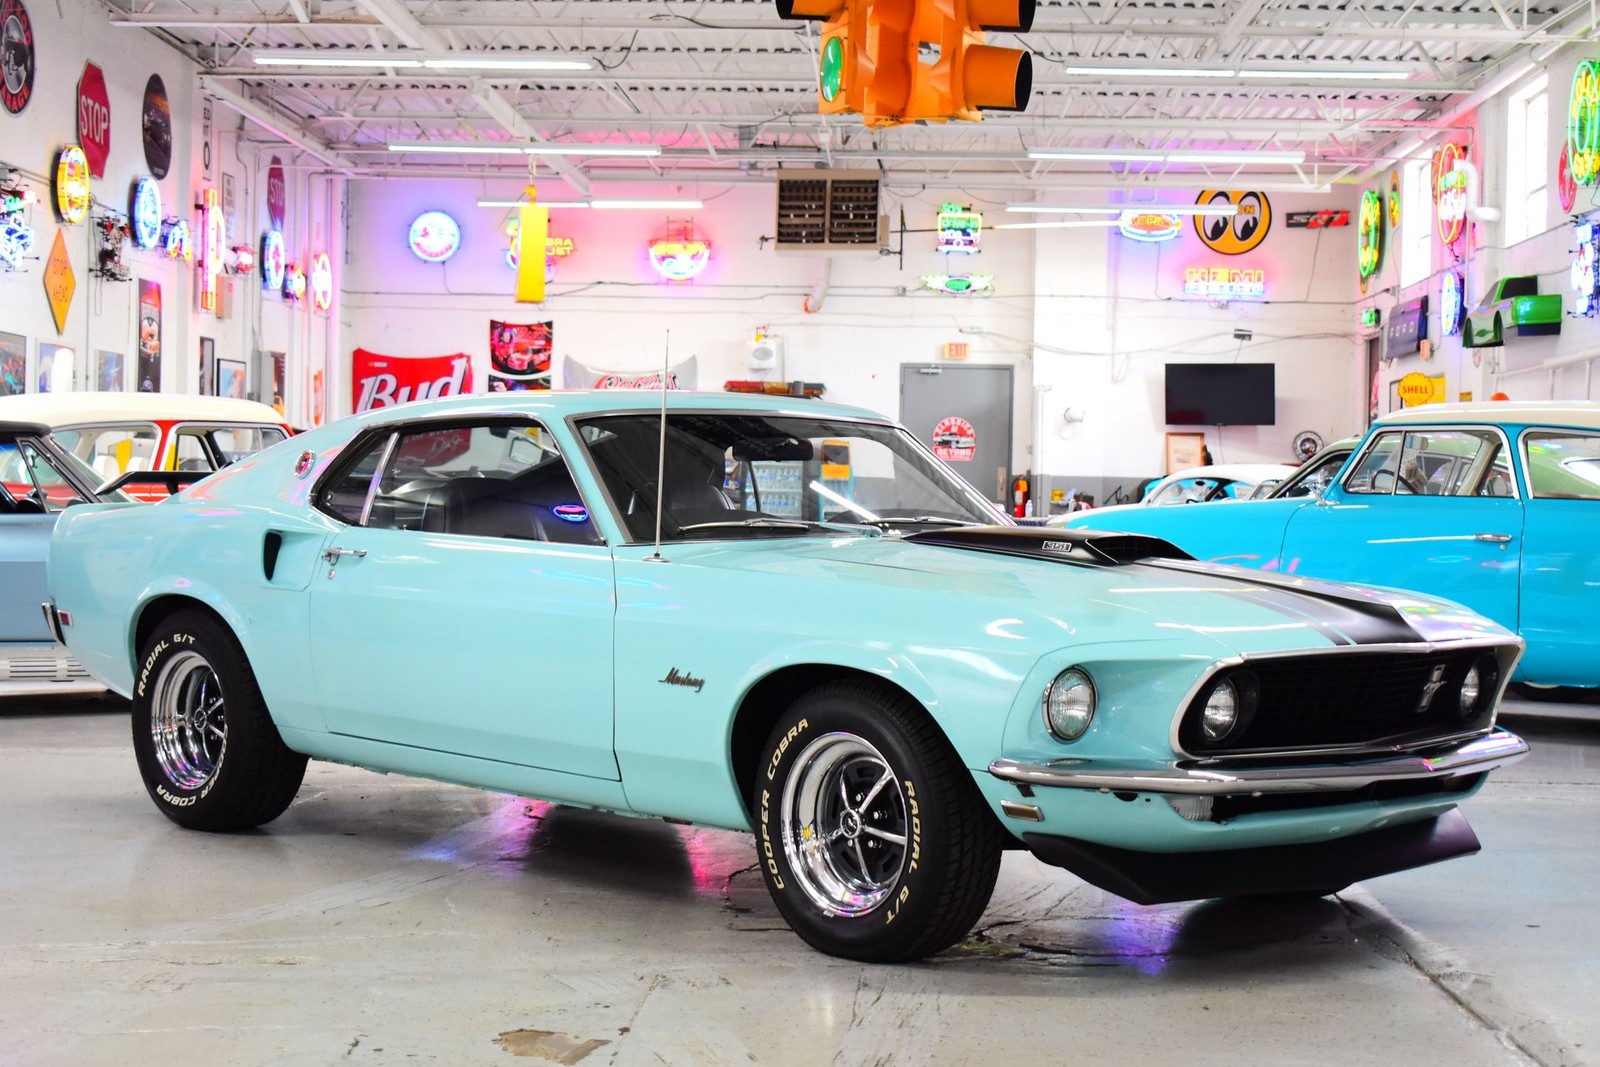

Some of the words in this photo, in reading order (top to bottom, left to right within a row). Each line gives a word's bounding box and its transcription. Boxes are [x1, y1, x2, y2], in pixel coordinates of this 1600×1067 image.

[81, 94, 109, 146] STOP
[1238, 204, 1255, 215] ON
[545, 237, 574, 247] BRA
[1389, 320, 1415, 339] FORD
[948, 342, 967, 358] EXIT
[1402, 385, 1430, 394] SHELL
[138, 640, 170, 697] RADIAL
[173, 633, 196, 645] G/T
[658, 666, 705, 693] Mustang
[767, 718, 809, 781] COBRA
[156, 784, 197, 807] COBRA
[761, 789, 785, 889] COOPER
[903, 780, 922, 873] RADIAL
[886, 885, 910, 924] G/T
